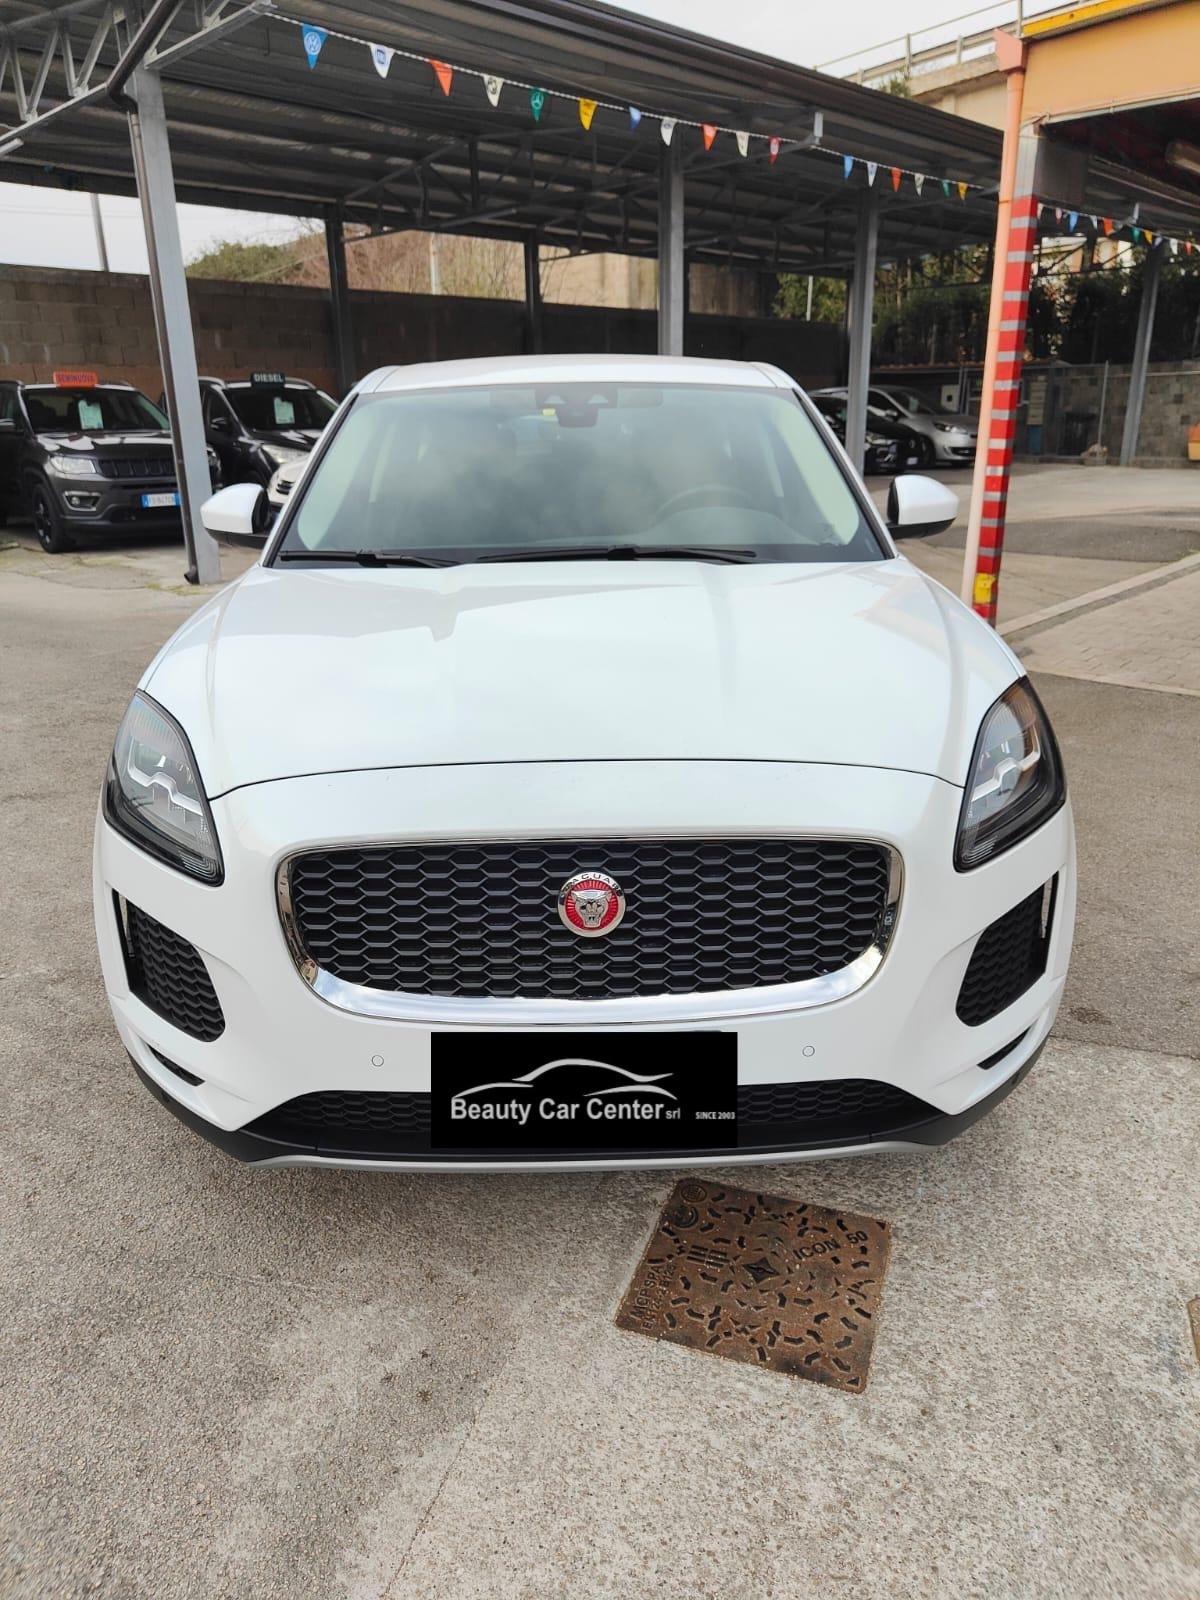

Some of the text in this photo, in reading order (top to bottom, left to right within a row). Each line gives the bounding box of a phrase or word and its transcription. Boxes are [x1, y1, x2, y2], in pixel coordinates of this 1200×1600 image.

[253, 373, 285, 383] DIESEL
[794, 1230, 869, 1260] ICON 50
